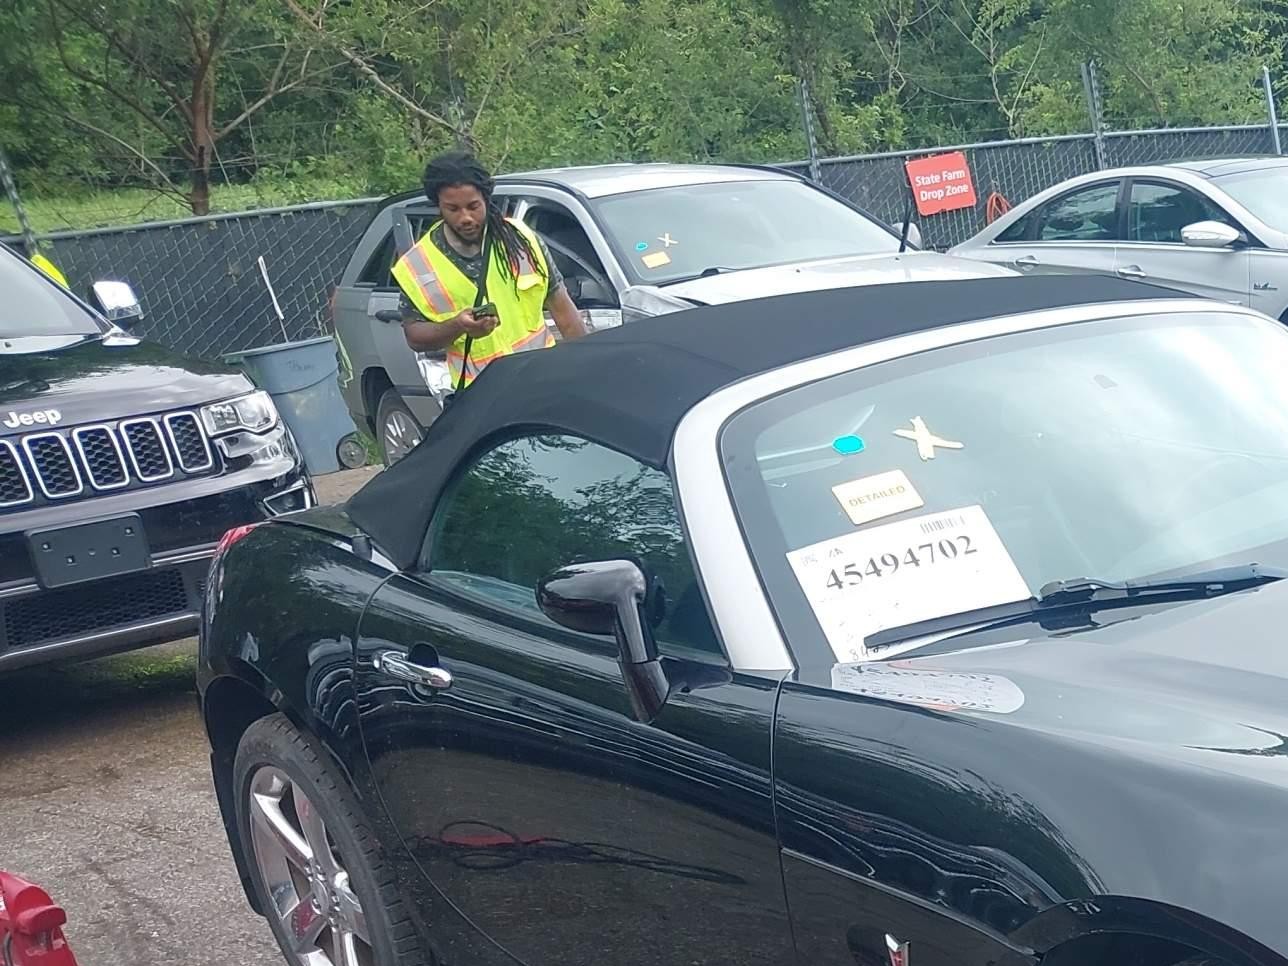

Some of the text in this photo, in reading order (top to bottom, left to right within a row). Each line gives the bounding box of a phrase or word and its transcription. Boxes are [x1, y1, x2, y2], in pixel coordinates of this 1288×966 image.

[915, 170, 965, 186] State Farm
[920, 184, 969, 201] Drop Zone
[3, 408, 62, 428] Jeep
[848, 485, 906, 507] DETAILED
[826, 535, 978, 590] 45494702
